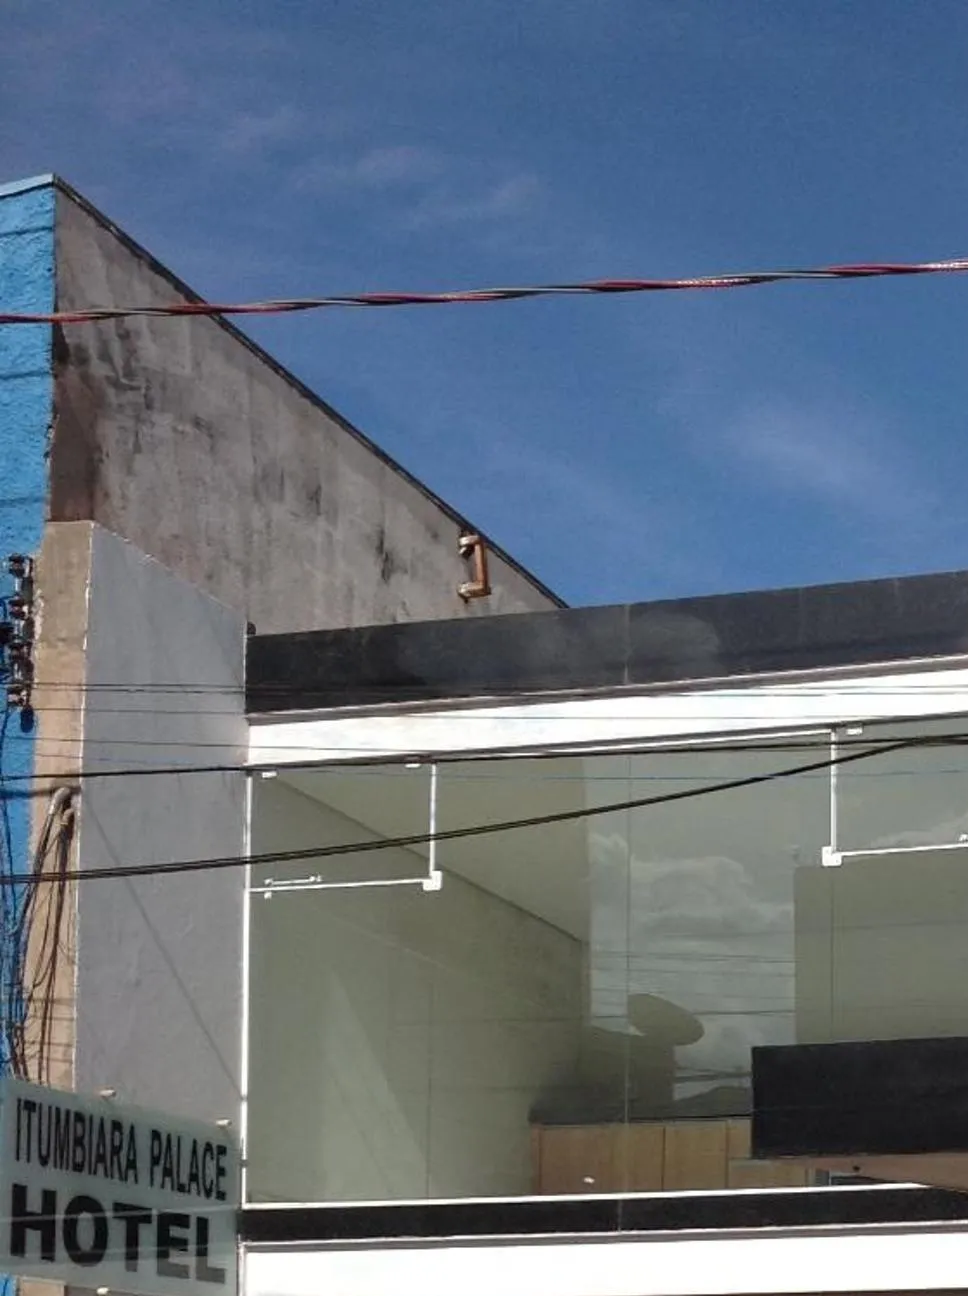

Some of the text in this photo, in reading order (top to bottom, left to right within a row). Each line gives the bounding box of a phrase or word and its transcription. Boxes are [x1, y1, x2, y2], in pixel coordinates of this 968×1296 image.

[15, 1097, 228, 1201] ITUMBIARA PALACE
[10, 1182, 226, 1284] HOTEL
